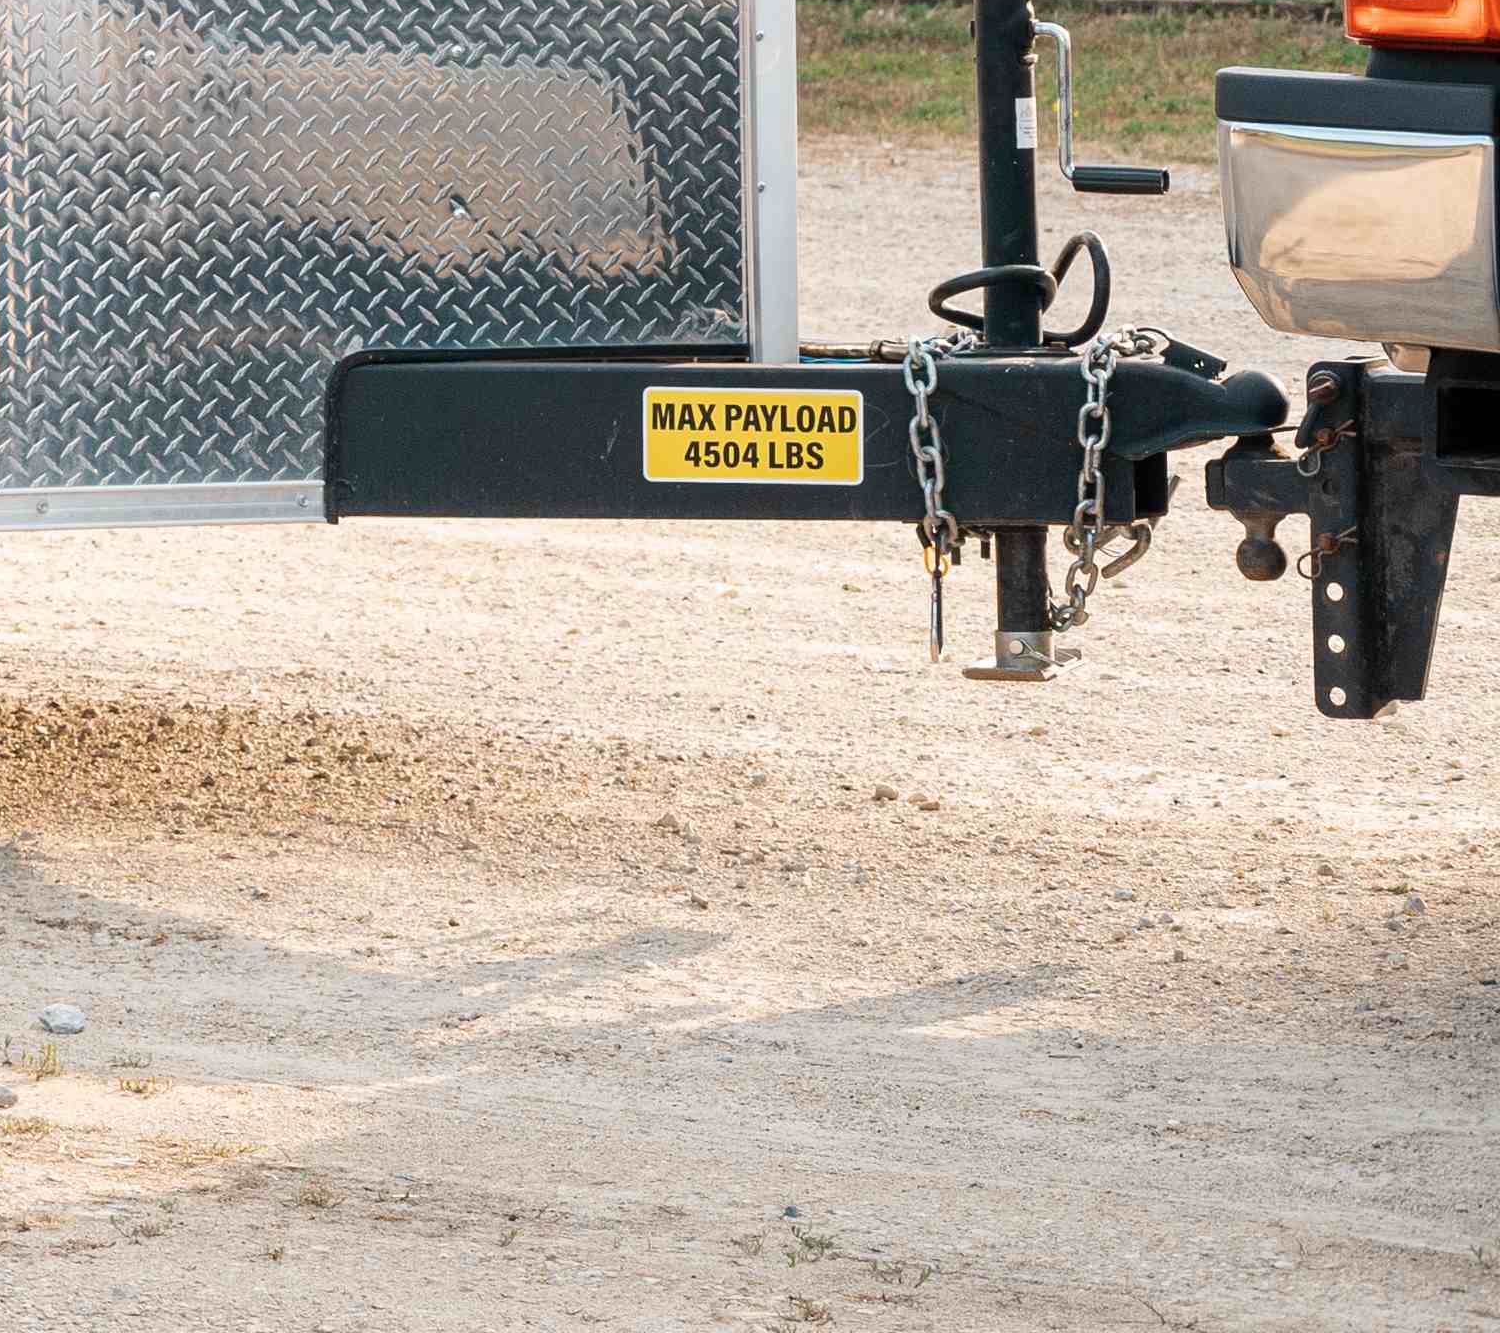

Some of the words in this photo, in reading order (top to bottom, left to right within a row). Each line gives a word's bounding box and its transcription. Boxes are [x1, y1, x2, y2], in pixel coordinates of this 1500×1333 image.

[652, 403, 716, 431] MAX
[725, 405, 857, 433] PAYLOAD
[684, 441, 760, 468] 4504
[769, 442, 824, 470] LBS
